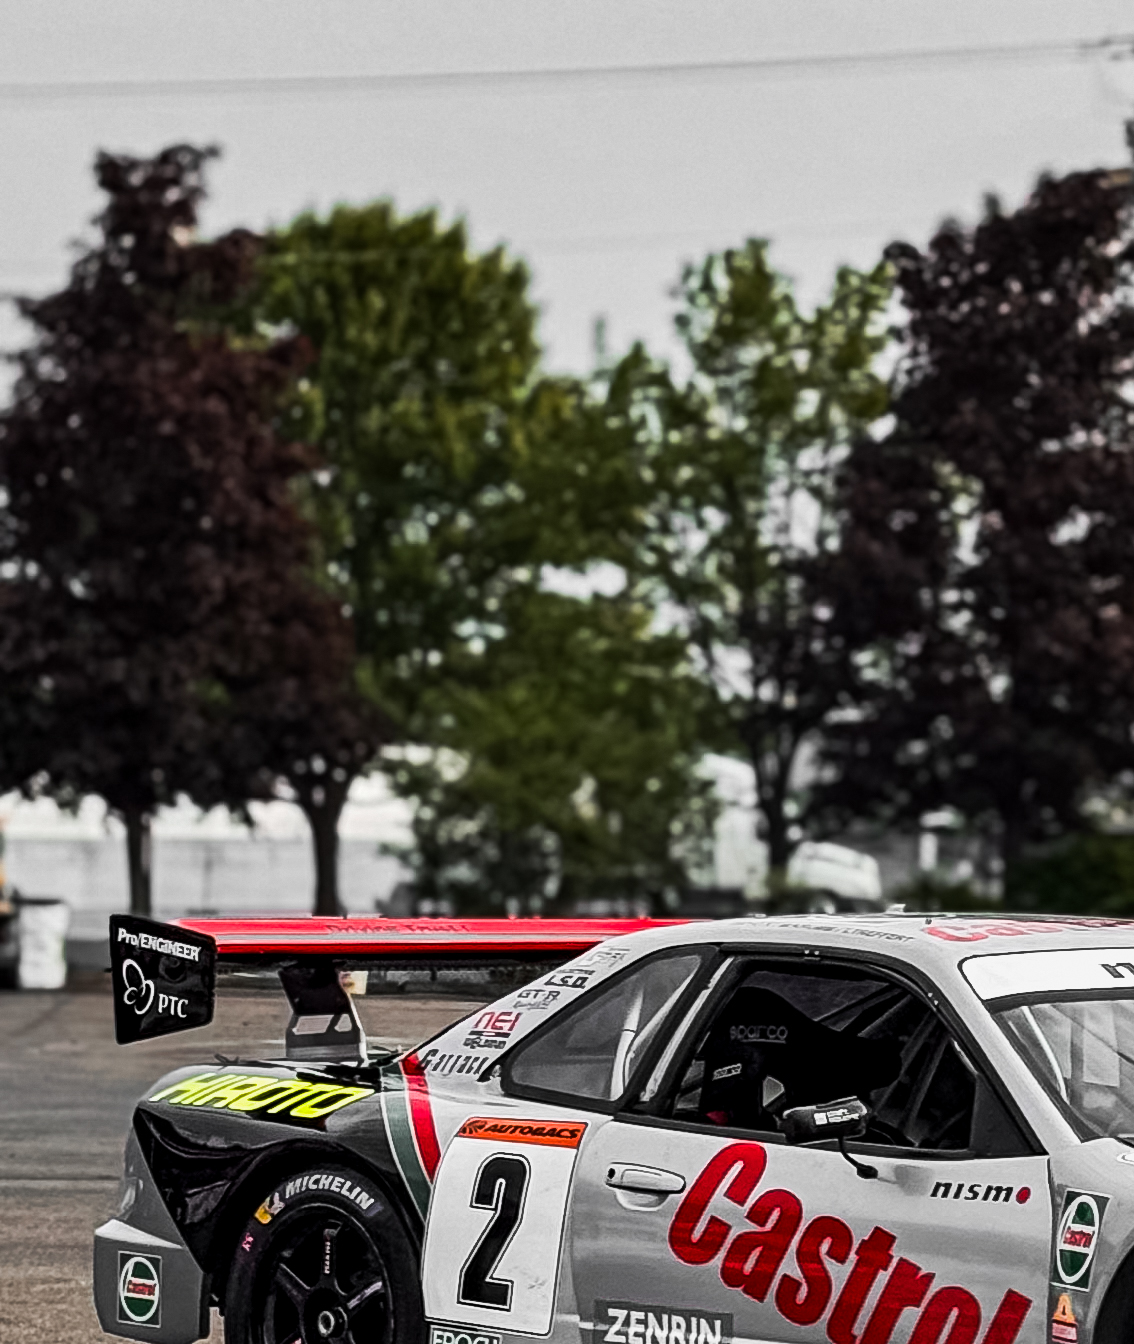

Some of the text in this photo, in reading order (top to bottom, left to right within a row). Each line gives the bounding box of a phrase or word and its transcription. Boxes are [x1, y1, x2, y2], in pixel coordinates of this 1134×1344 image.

[158, 993, 189, 1018] PTC
[730, 1025, 788, 1040] sparco
[148, 1072, 376, 1119] HIROTO
[484, 1122, 581, 1140] AUTOBACS
[285, 1174, 375, 1211] MICHELIN
[456, 1151, 532, 1313] 2
